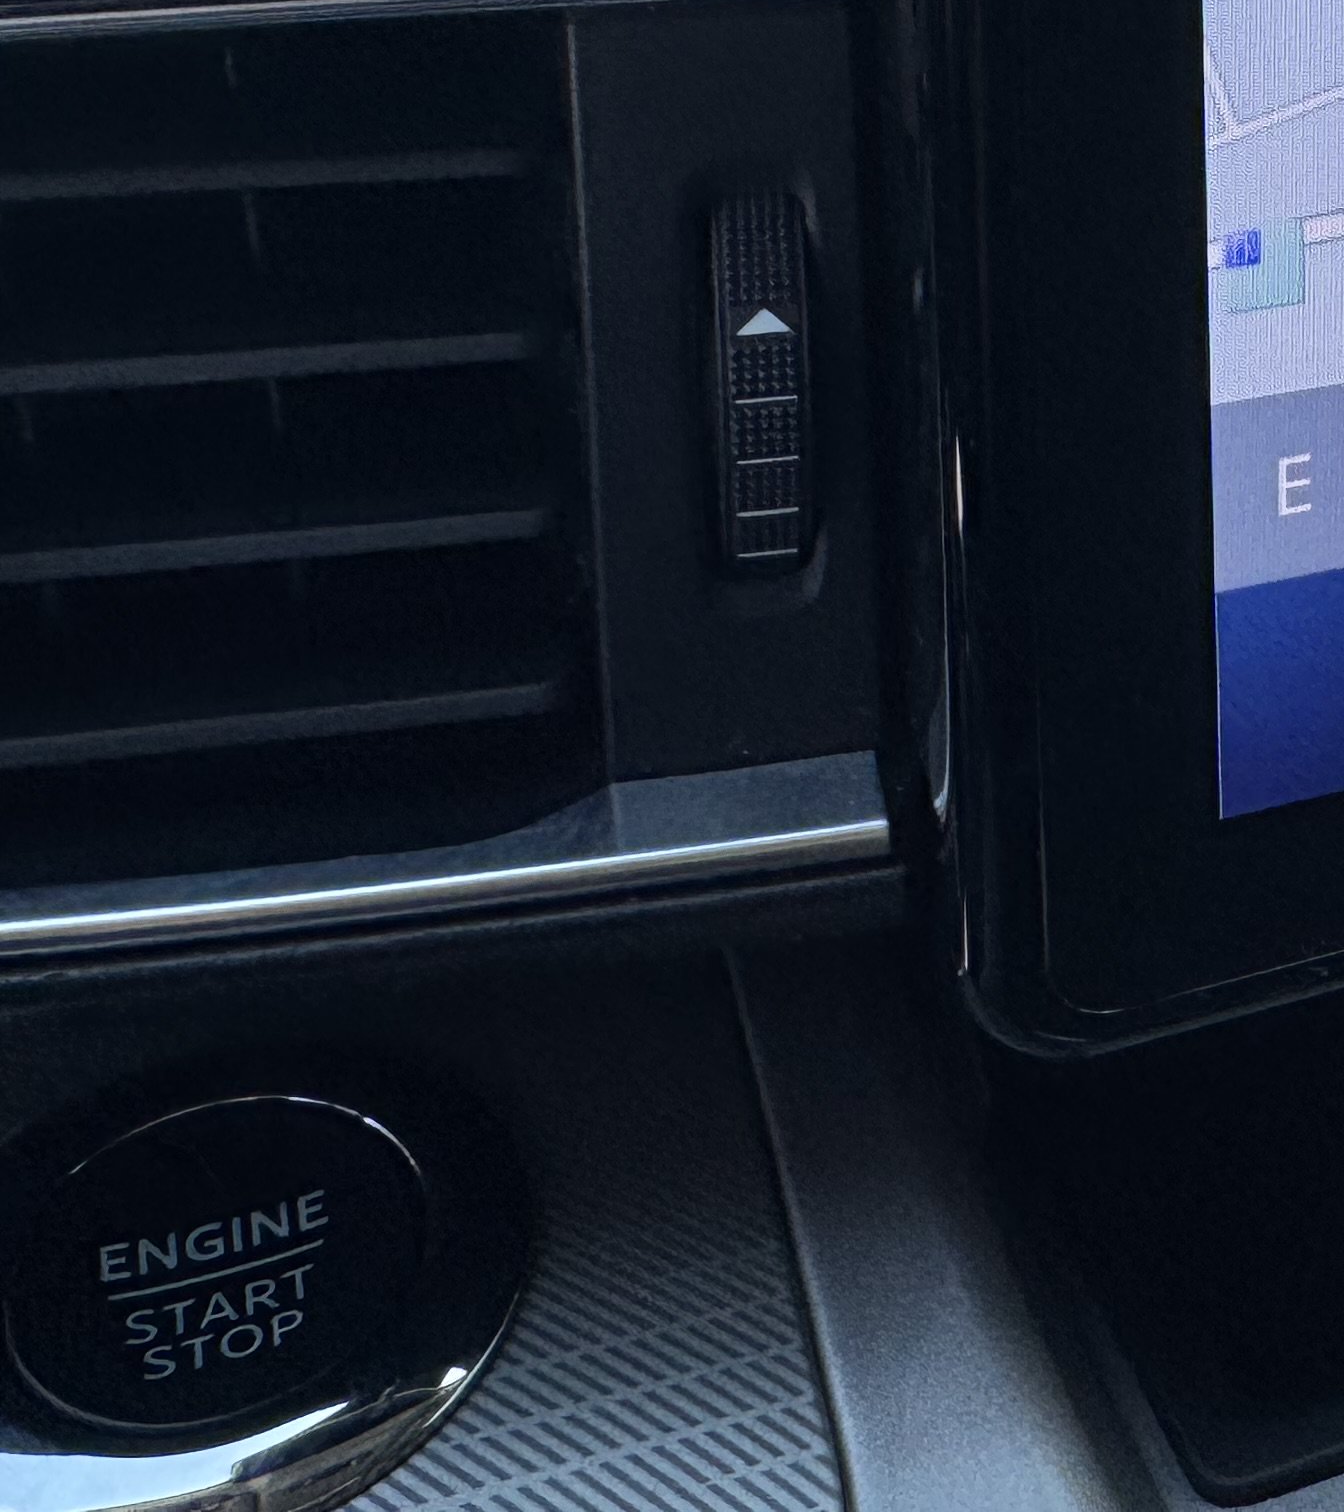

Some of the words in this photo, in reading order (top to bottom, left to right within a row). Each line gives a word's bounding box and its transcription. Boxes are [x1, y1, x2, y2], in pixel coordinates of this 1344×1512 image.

[1277, 453, 1312, 518] E
[99, 1189, 330, 1282] ENGINE
[124, 1264, 314, 1347] START
[142, 1309, 304, 1381] STOP
